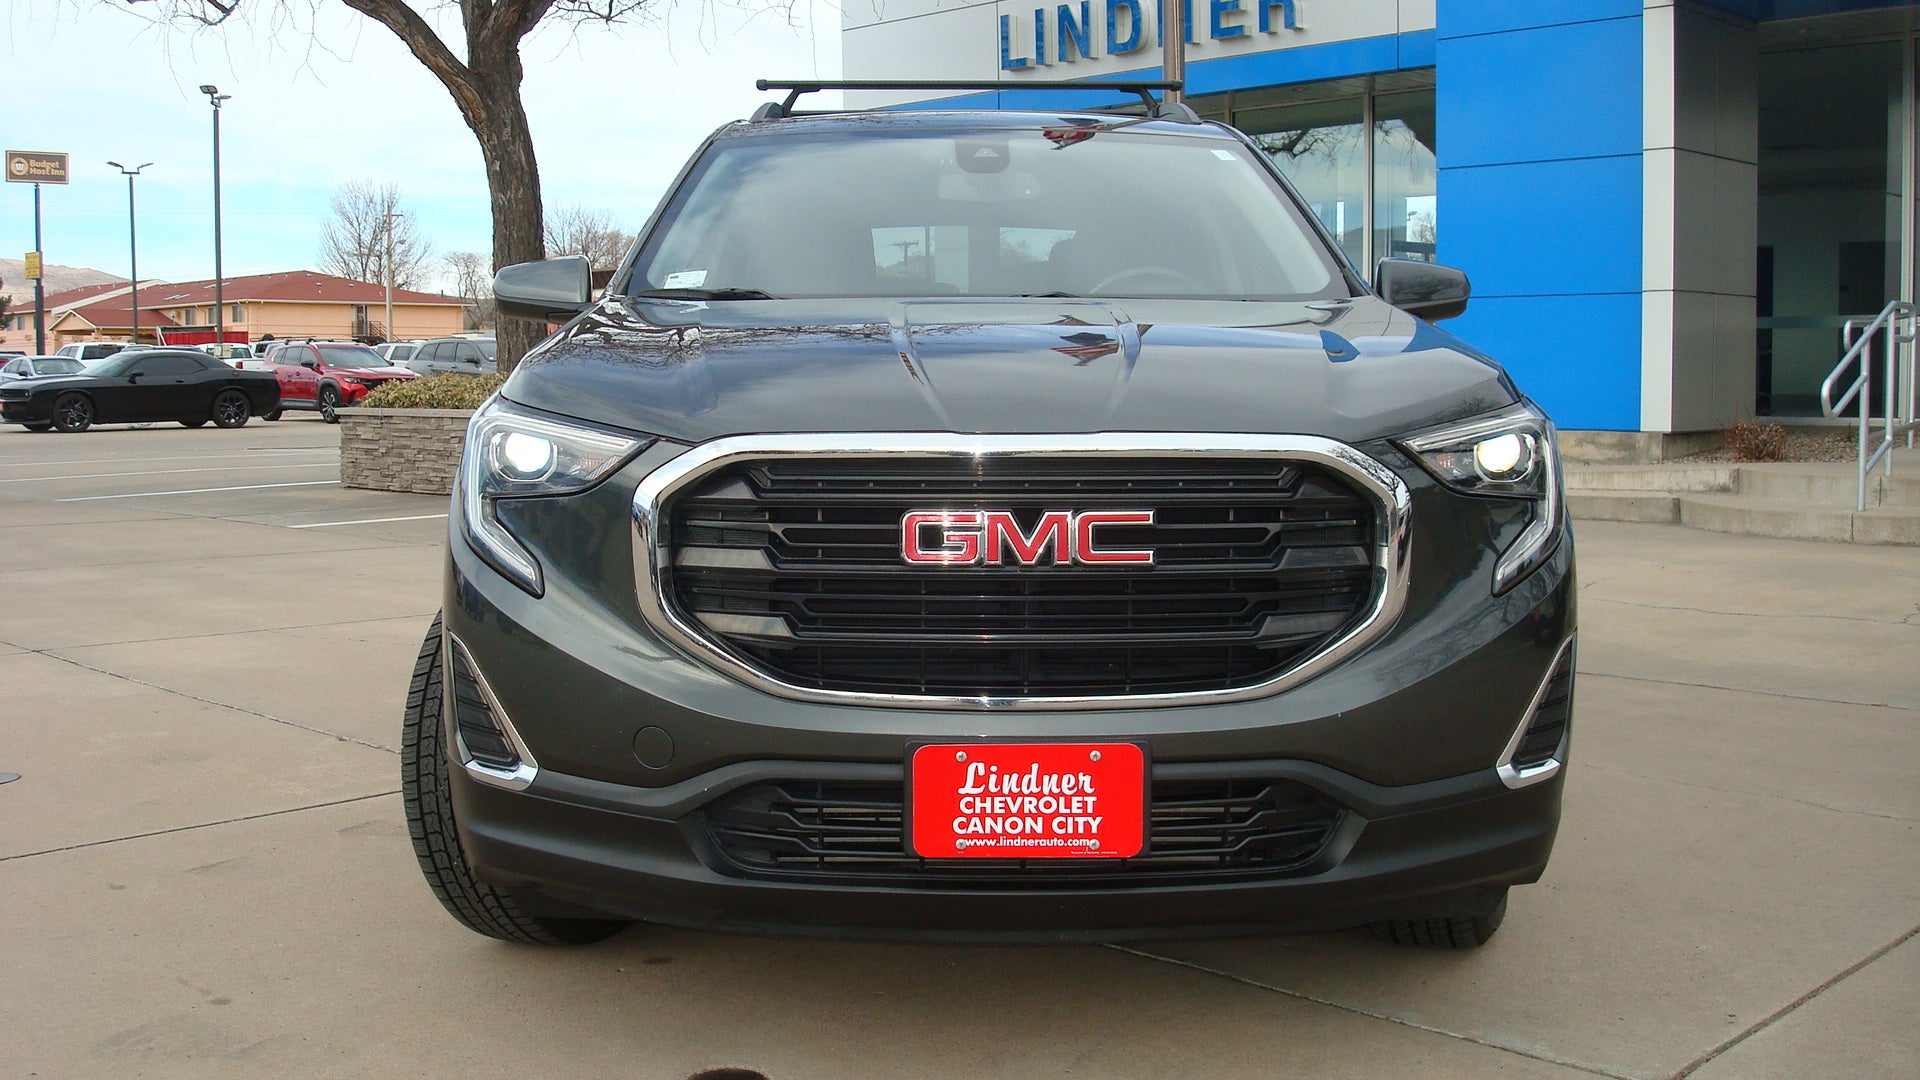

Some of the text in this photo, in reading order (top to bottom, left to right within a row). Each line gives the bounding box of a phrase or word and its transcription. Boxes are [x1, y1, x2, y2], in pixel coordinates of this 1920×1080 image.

[29, 159, 60, 169] Budget
[29, 167, 50, 175] Host
[901, 510, 1155, 565] GMC
[957, 762, 1096, 795] Lindner
[959, 796, 1097, 814] CHEVROLET
[952, 816, 1103, 834] CANON CITY
[964, 836, 1090, 847] www.lindnerauto.com
